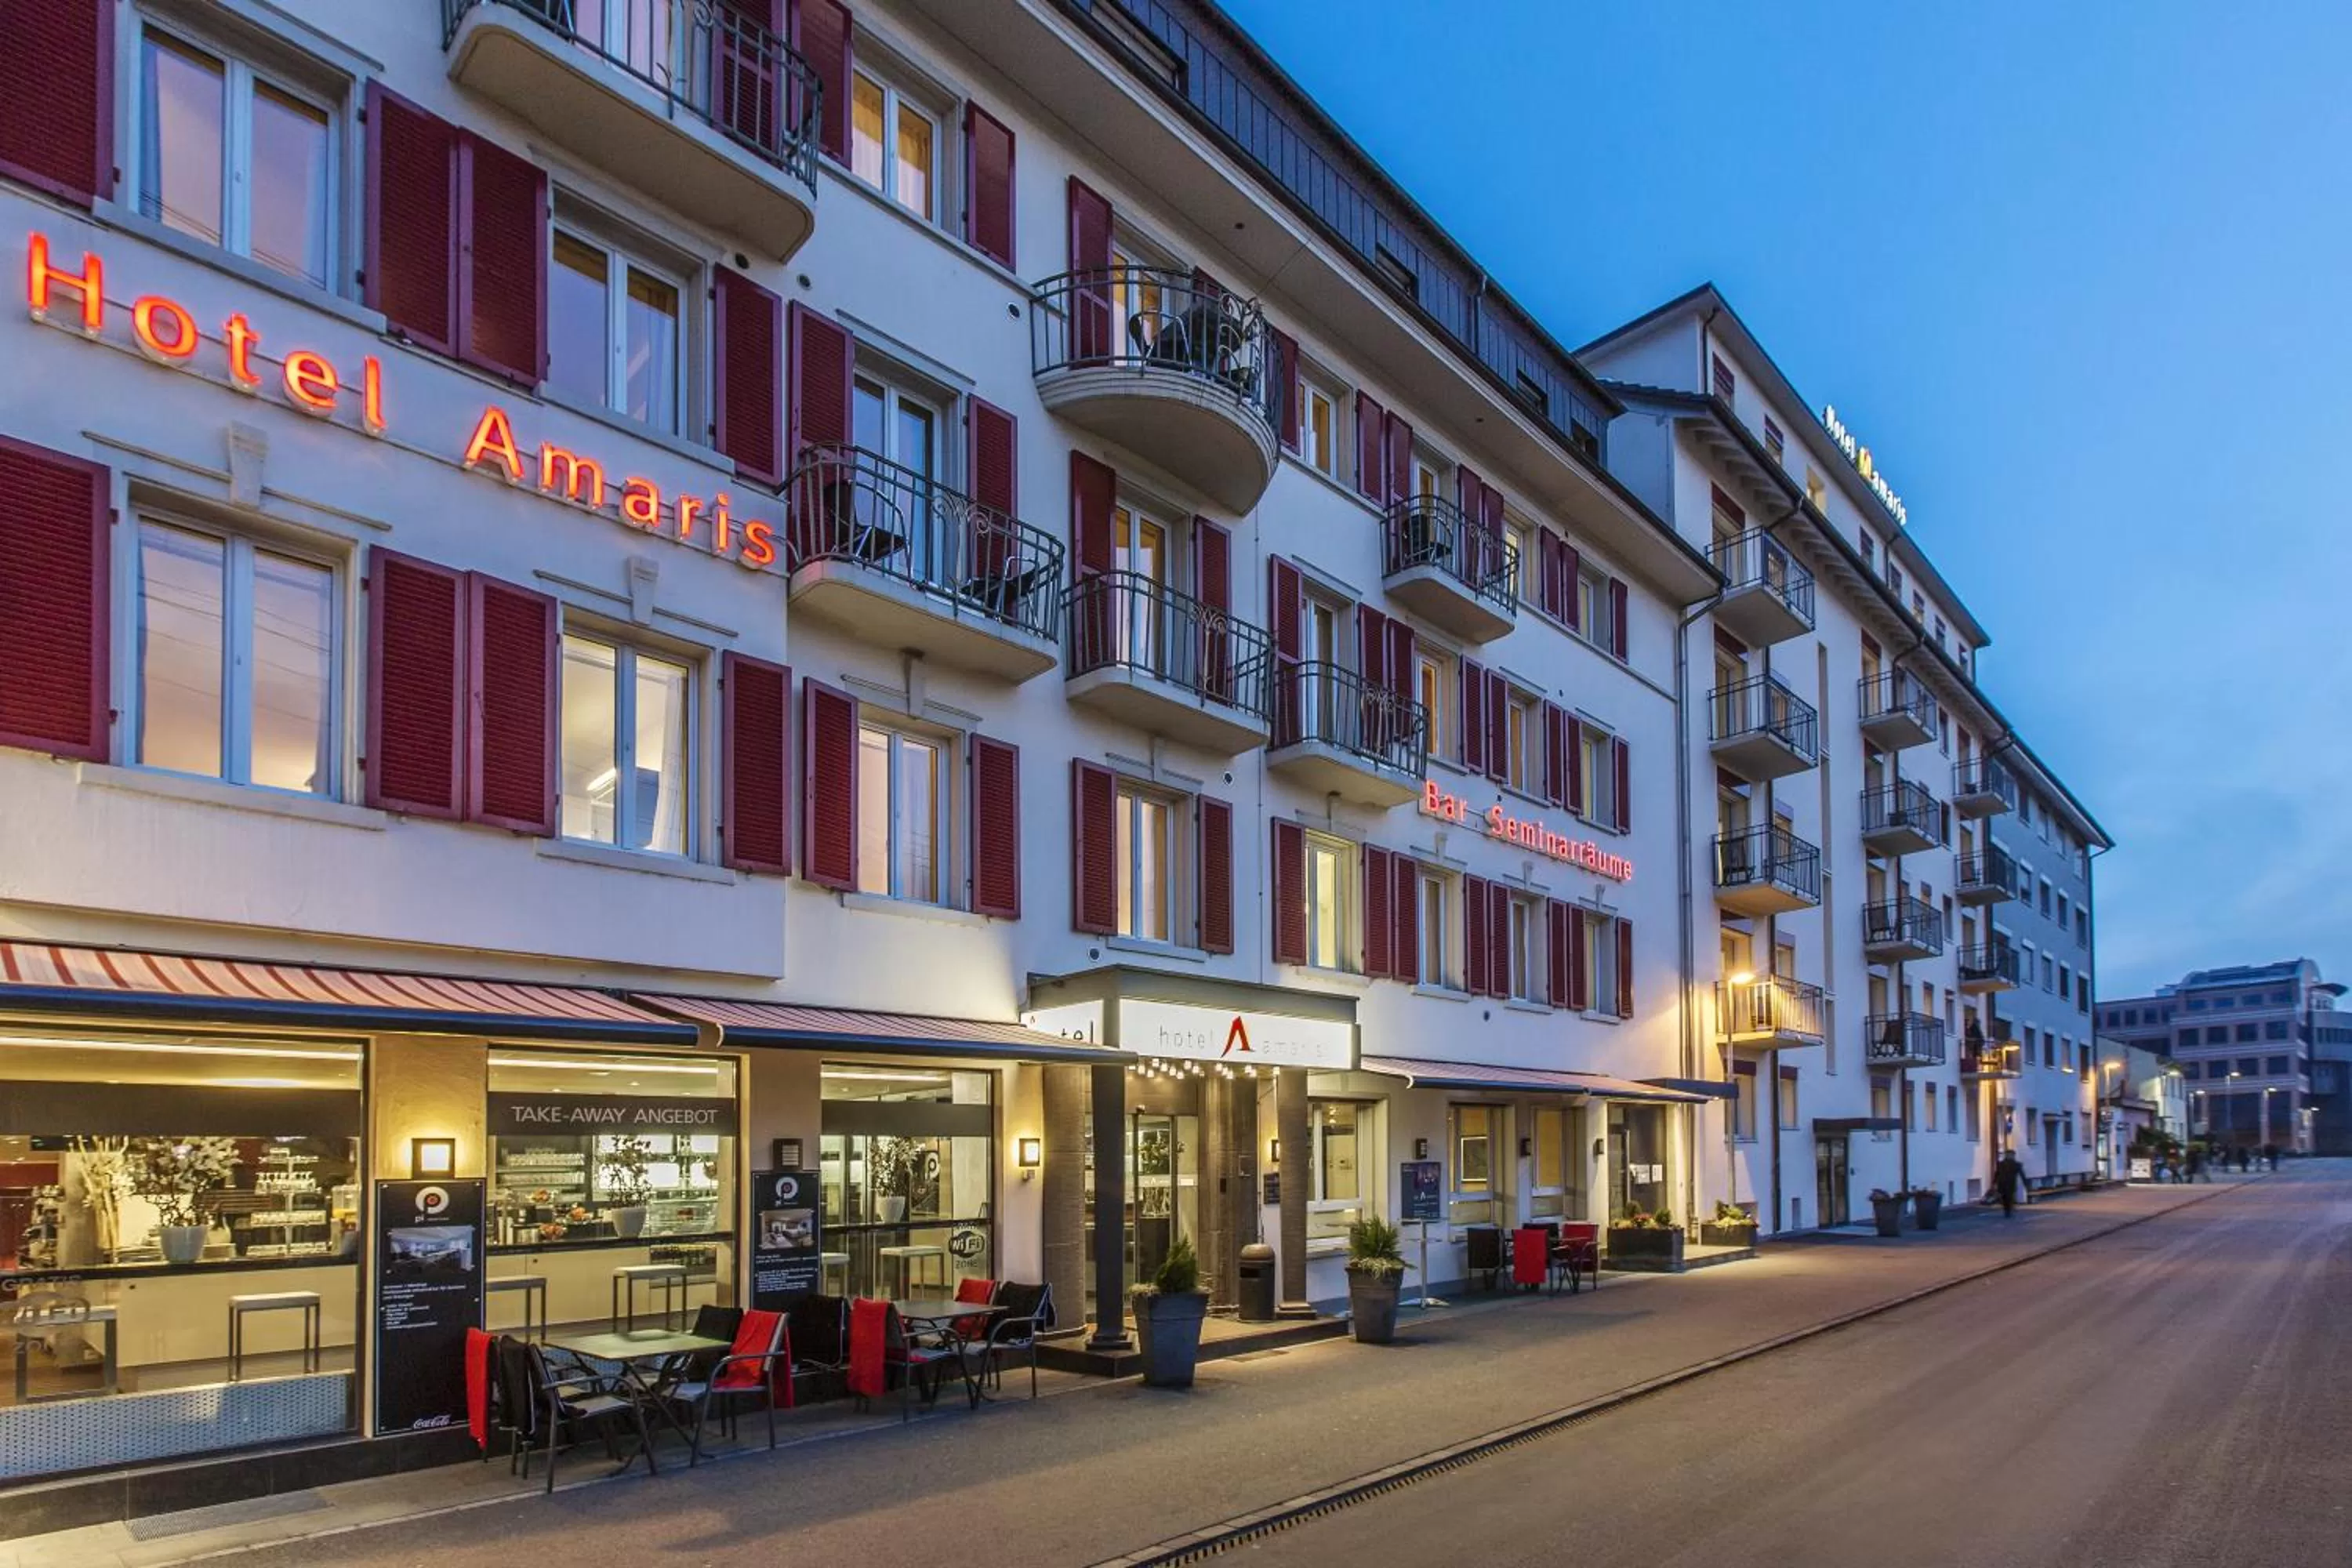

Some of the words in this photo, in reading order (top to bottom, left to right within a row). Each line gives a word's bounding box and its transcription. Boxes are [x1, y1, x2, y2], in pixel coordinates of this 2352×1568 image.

[26, 230, 387, 430] Hotel
[463, 404, 778, 568] Amaris
[1425, 778, 1468, 822] Bar
[1491, 804, 1633, 880] Seminarräume
[510, 1105, 626, 1123] TAKE-AWAY
[633, 1107, 719, 1124] ANGEBOT
